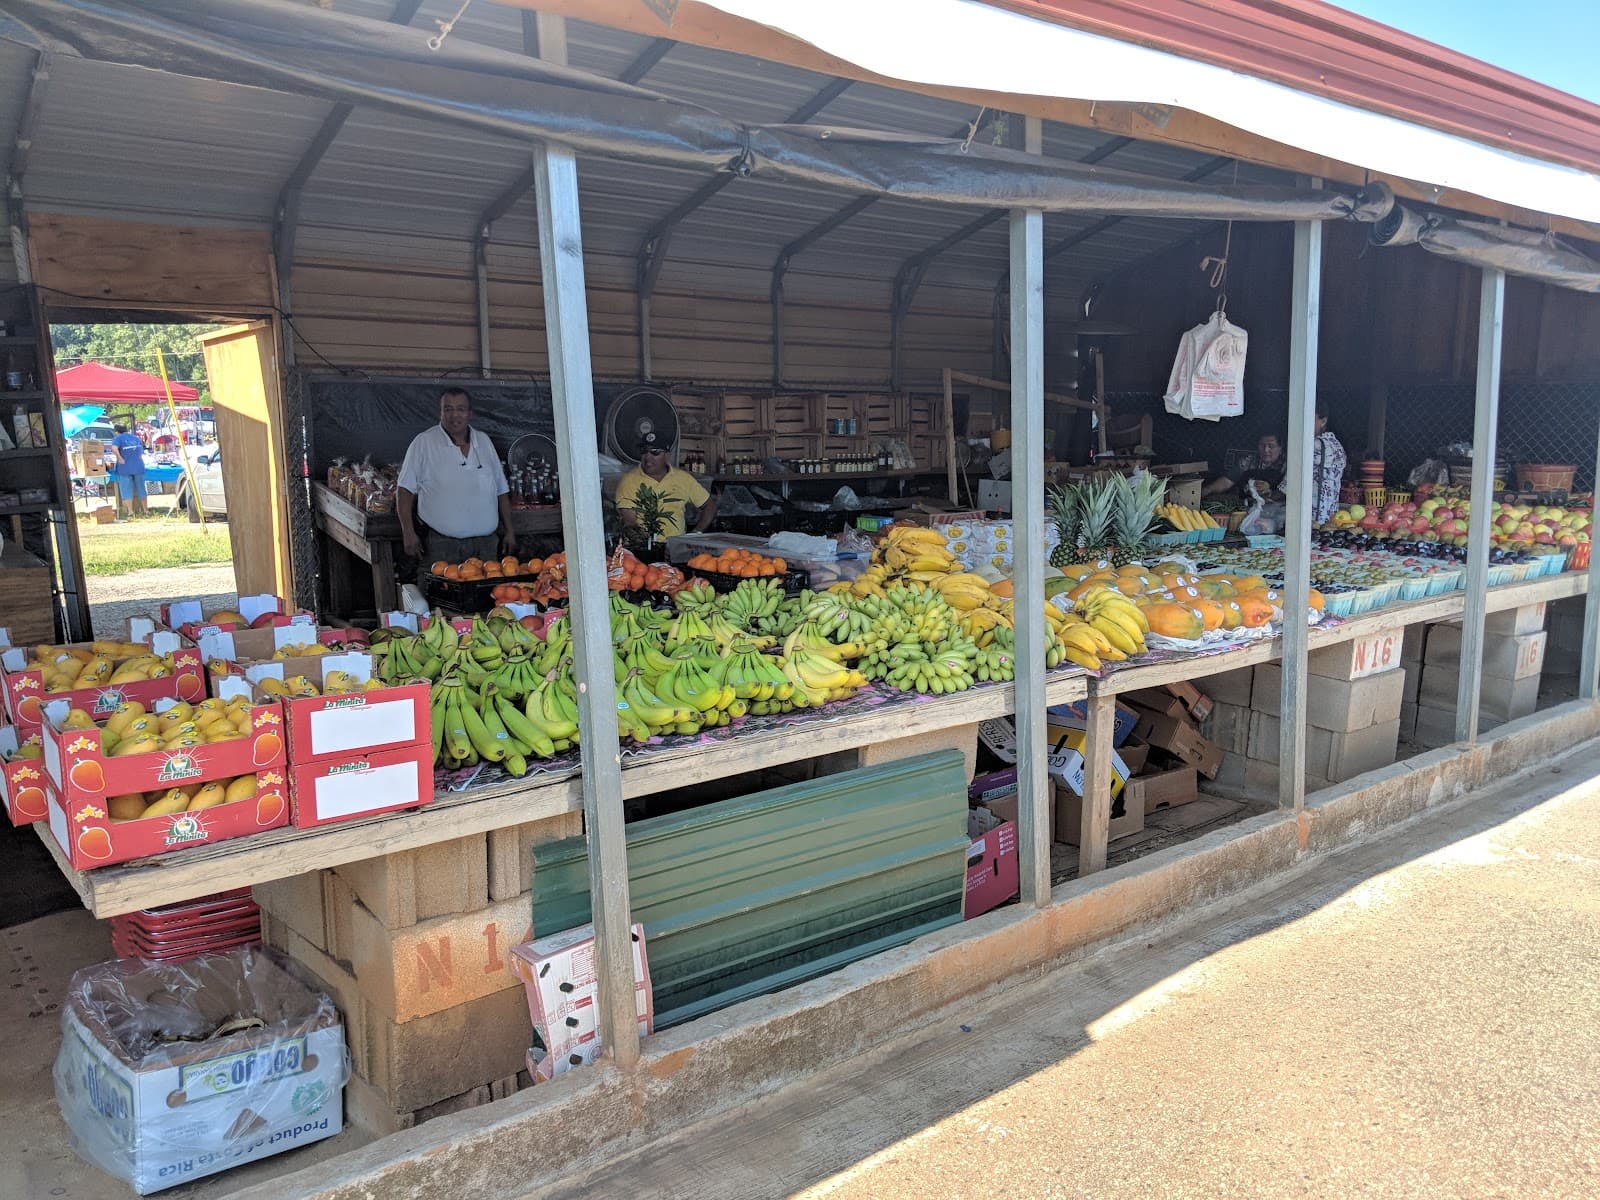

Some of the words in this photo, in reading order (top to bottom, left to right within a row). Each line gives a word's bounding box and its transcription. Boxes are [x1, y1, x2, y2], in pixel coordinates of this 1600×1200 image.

[269, 1118, 328, 1145] Product
[199, 1147, 243, 1165] Costa
[158, 1159, 194, 1177] Rica
